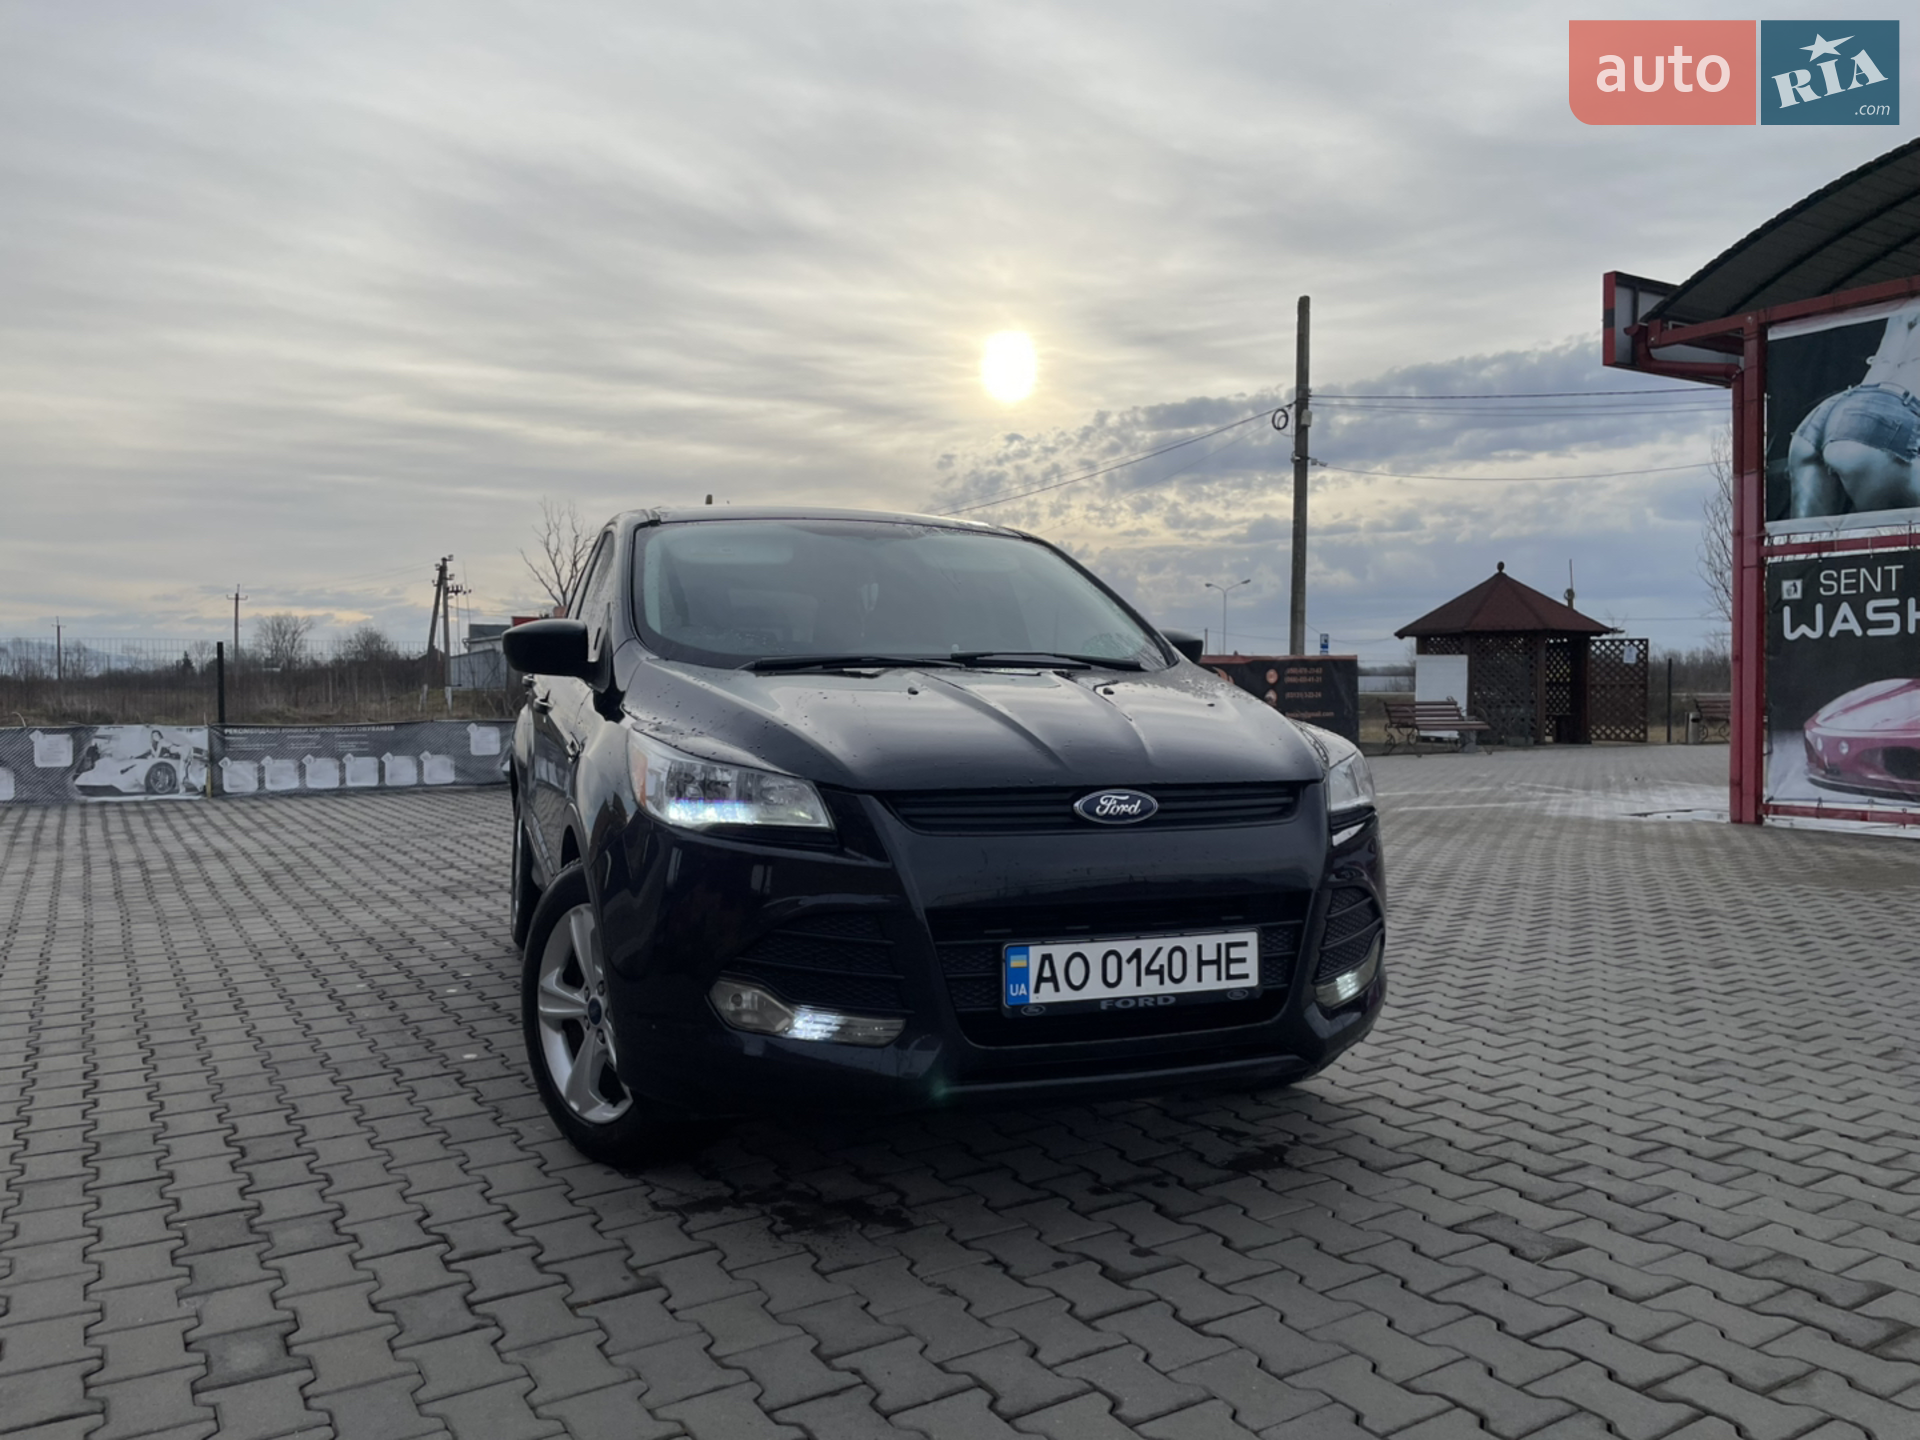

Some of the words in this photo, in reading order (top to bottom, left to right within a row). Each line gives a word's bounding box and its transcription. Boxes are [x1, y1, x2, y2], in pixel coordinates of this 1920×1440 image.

[1819, 565, 1904, 596] SENT
[1095, 794, 1141, 817] Ford
[1033, 951, 1090, 994] AO
[1101, 945, 1188, 989] 0140
[1197, 941, 1250, 983] HE
[1009, 983, 1028, 997] UA
[1100, 995, 1176, 1010] FORD
